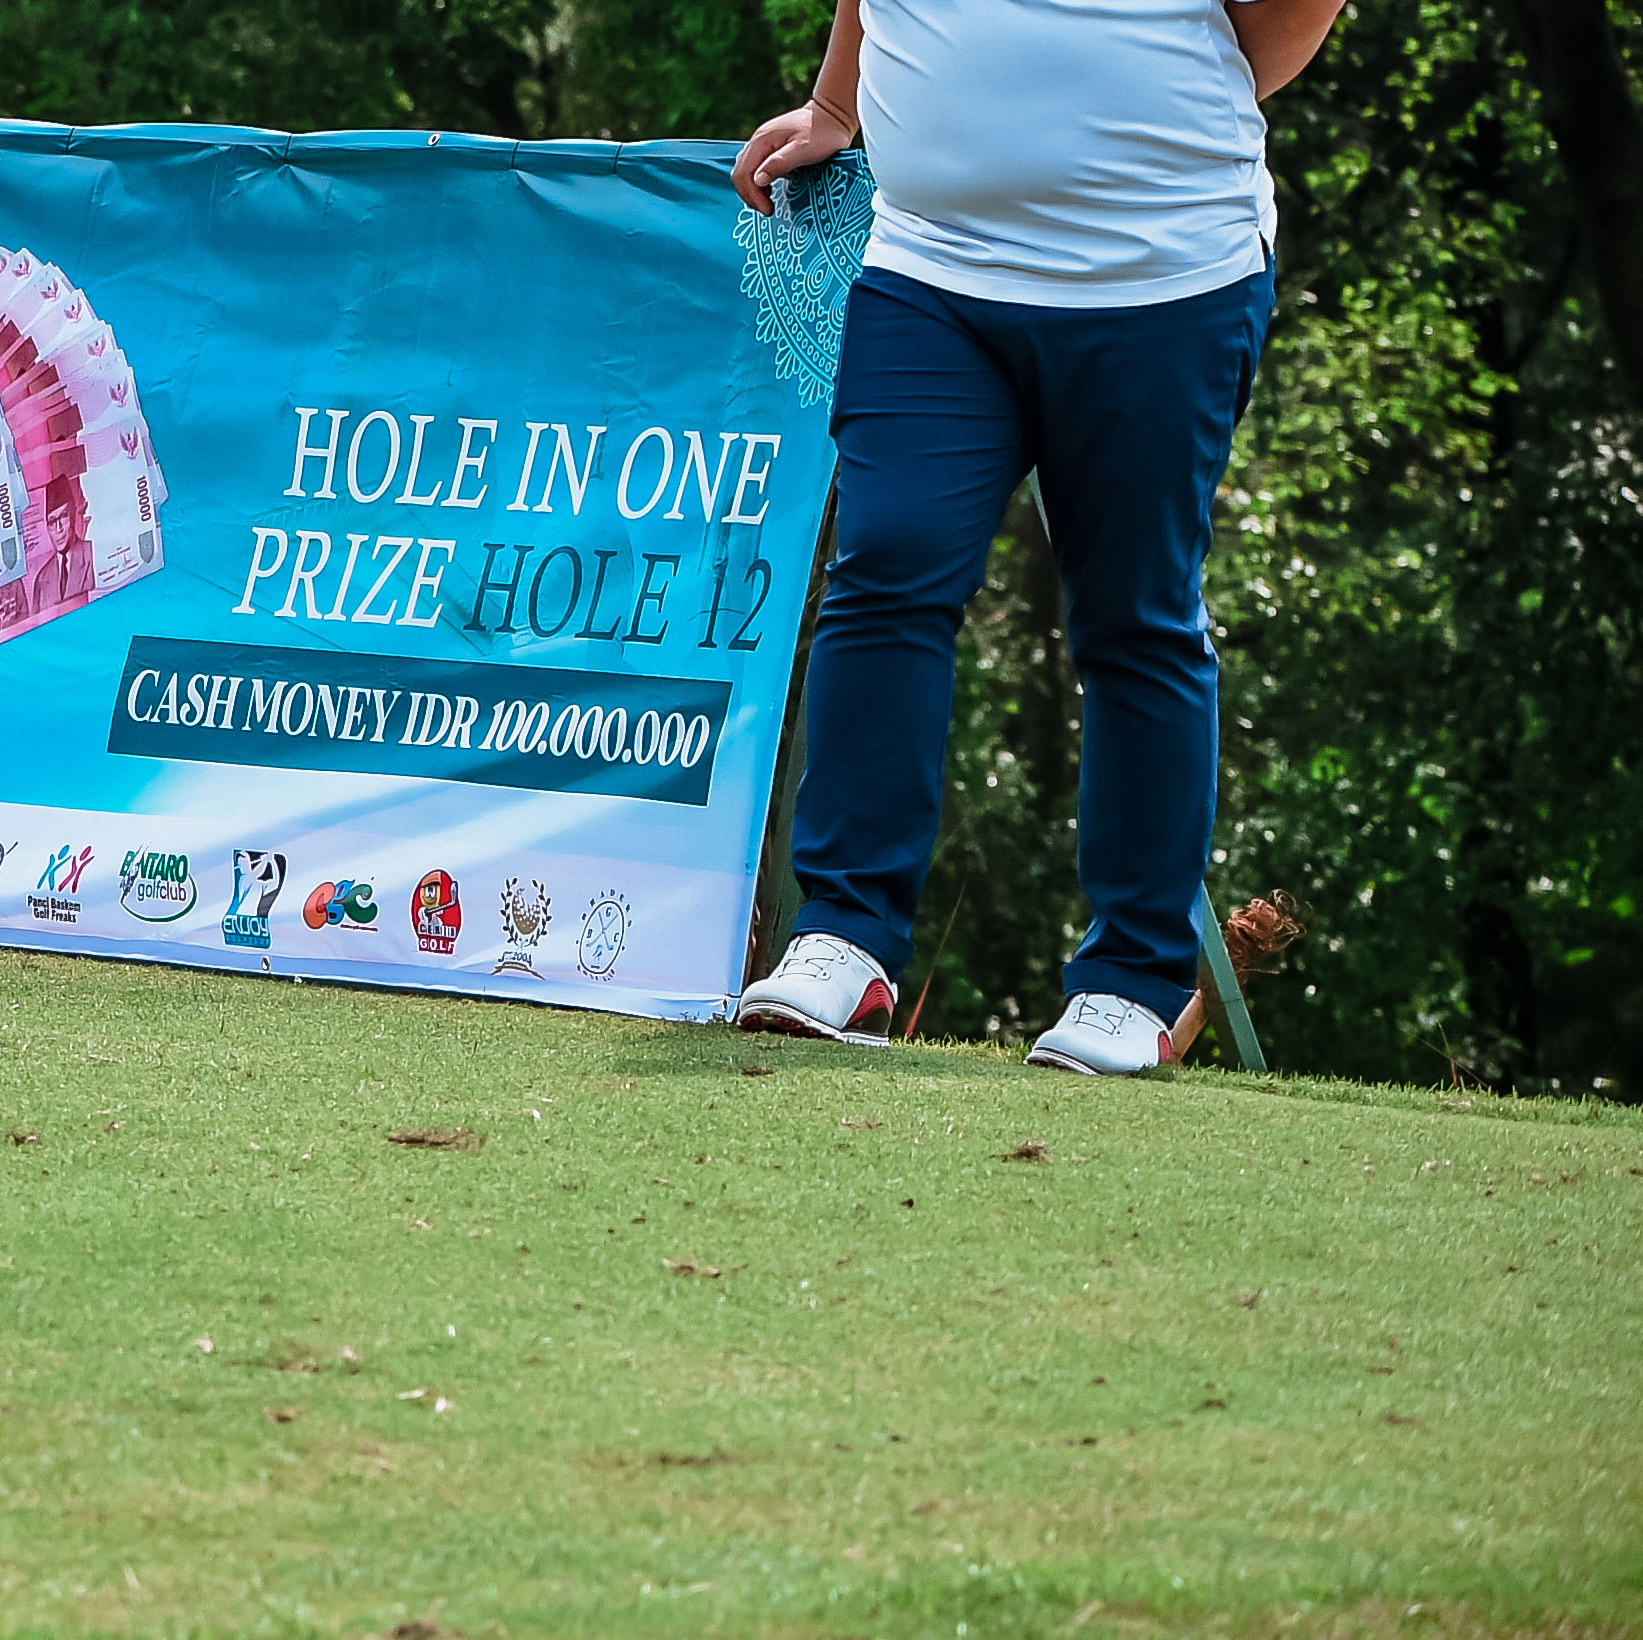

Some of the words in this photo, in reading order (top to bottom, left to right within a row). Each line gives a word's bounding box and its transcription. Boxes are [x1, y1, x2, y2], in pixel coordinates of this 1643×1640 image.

[283, 407, 499, 509] HOLE
[506, 420, 607, 516] IN
[616, 426, 782, 525] ONE
[136, 475, 151, 522] 100000
[231, 526, 457, 628] PRIZE
[463, 542, 681, 644] HOLE
[697, 558, 773, 652] 12
[127, 668, 245, 730] CASH
[242, 678, 401, 745] MONEY
[398, 690, 485, 751] IDR
[478, 699, 711, 769] 100.000.000
[138, 880, 187, 903] golfclub
[223, 914, 269, 937] ENJOY
[419, 938, 454, 952] GOLF
